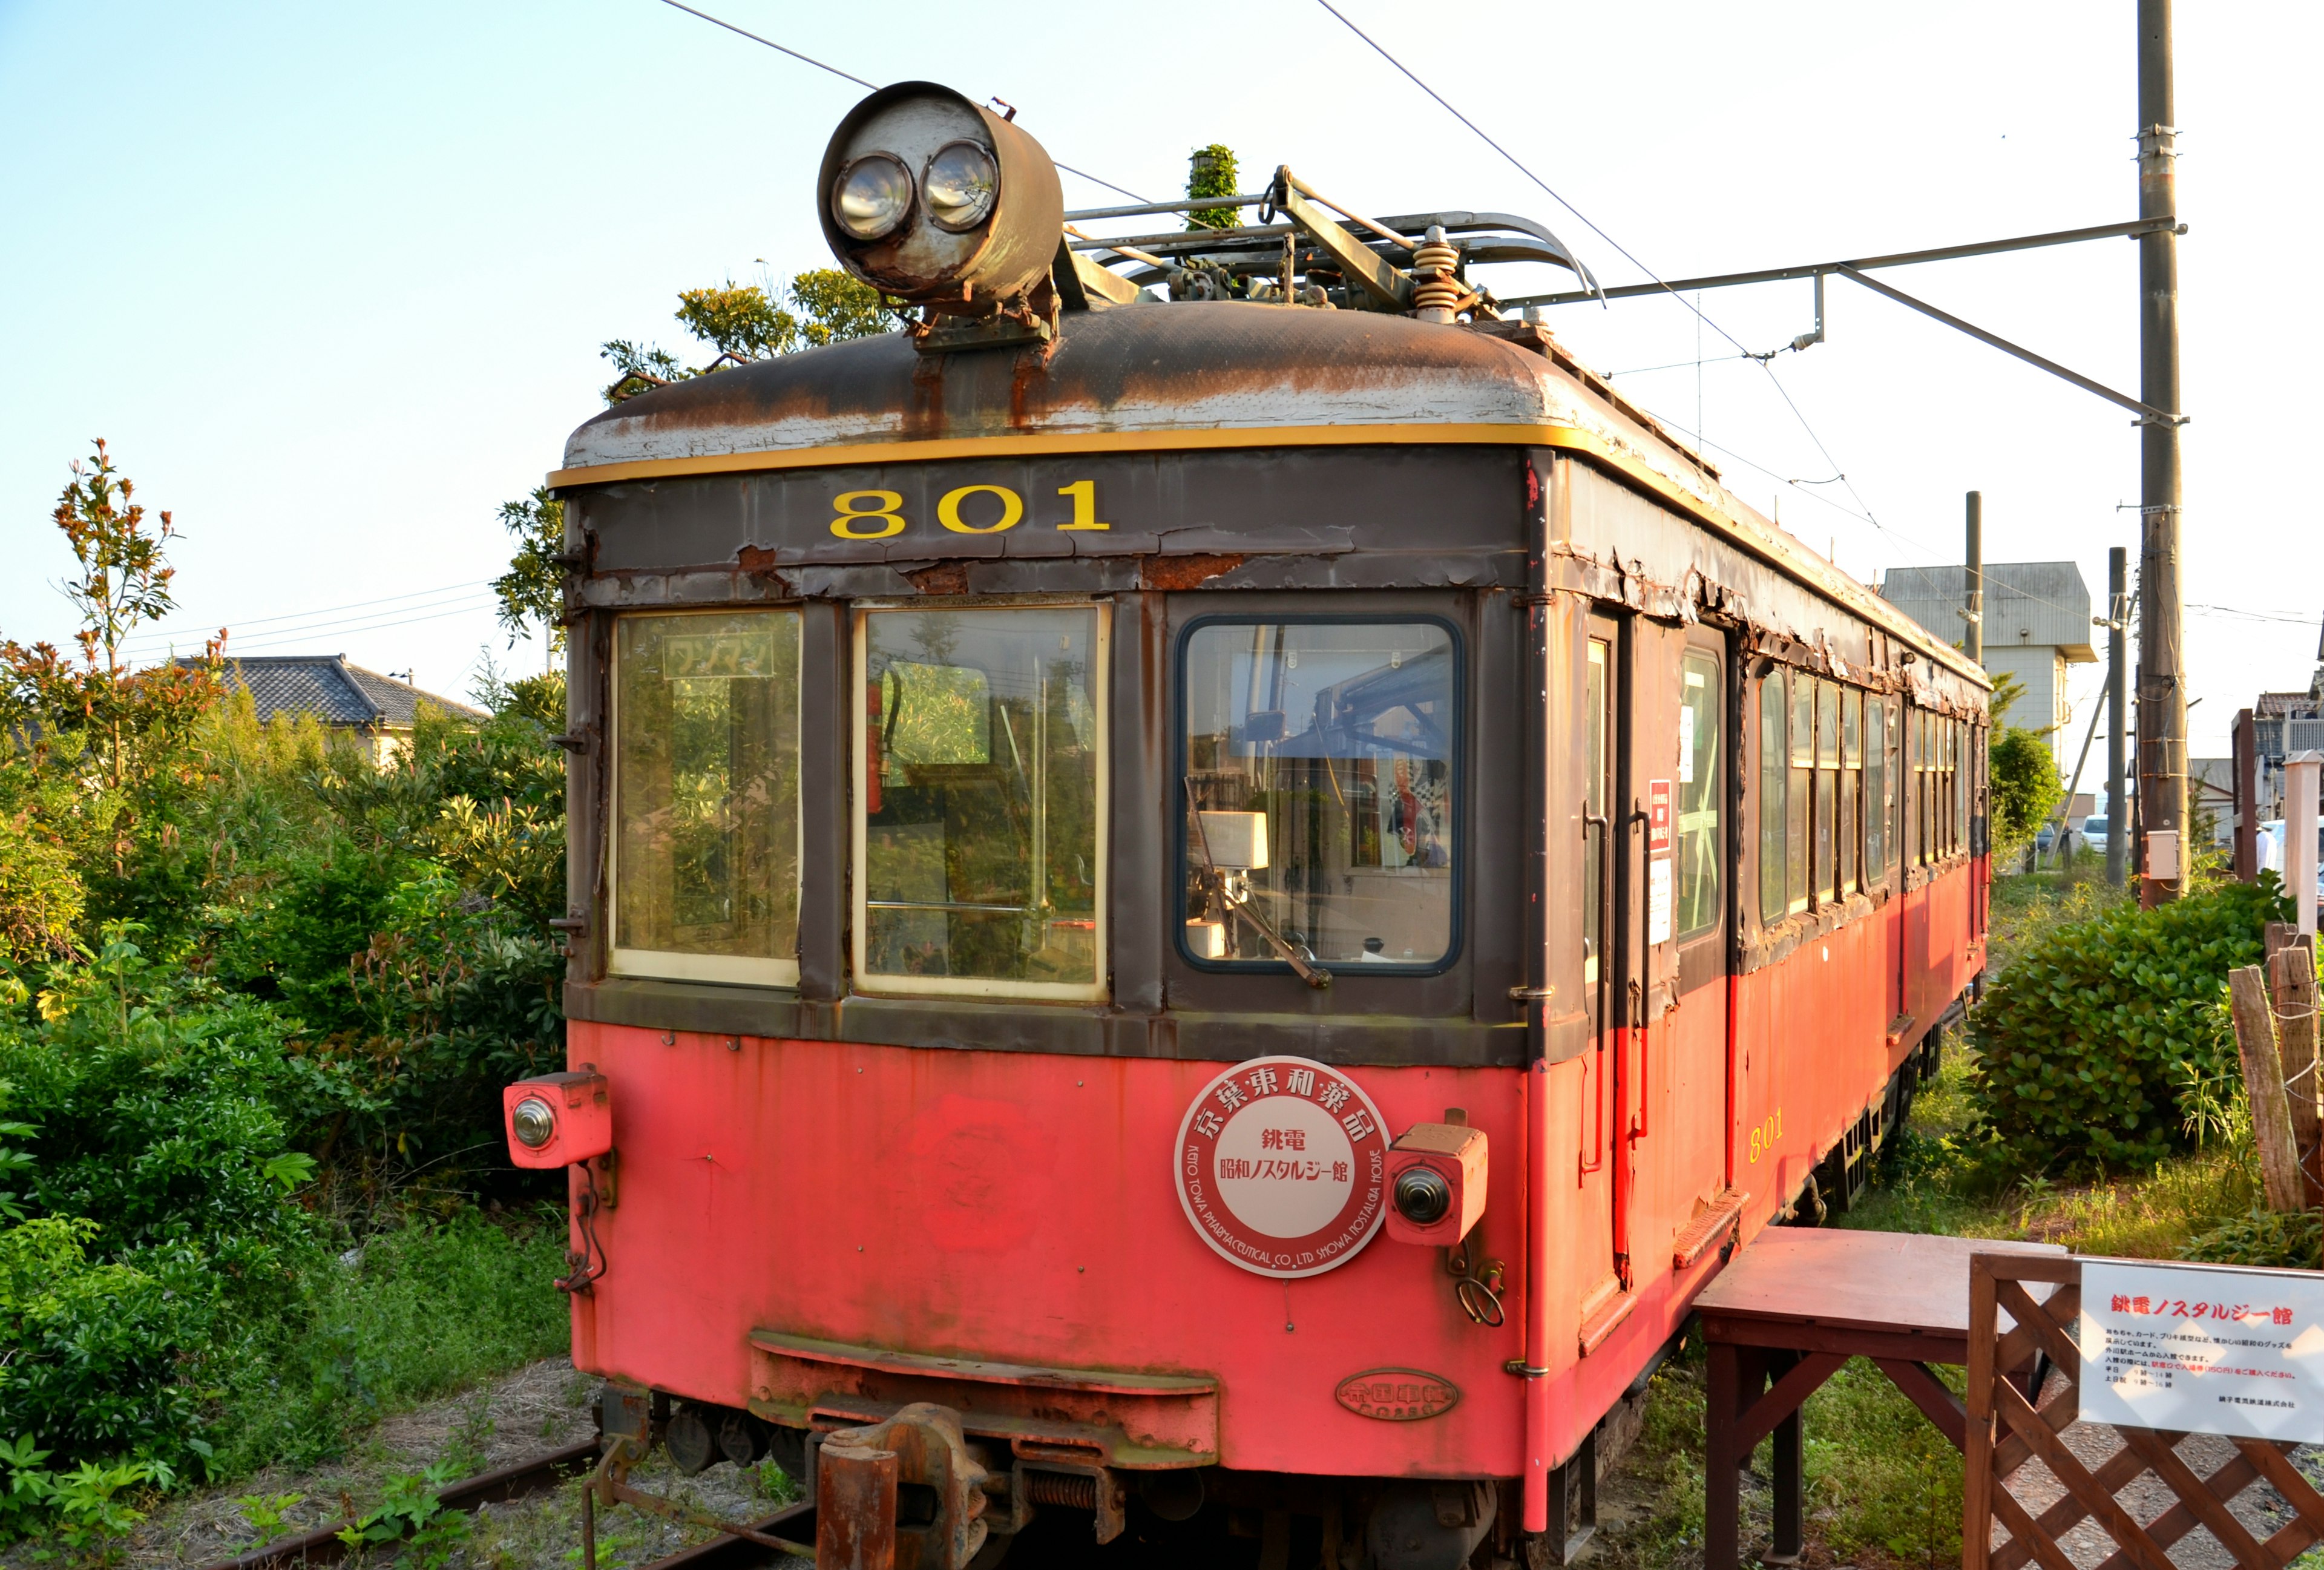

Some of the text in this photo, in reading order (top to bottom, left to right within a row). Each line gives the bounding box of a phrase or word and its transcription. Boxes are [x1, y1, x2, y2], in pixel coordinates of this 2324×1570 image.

[830, 480, 1110, 539] 801
[1193, 1068, 1375, 1142] 京葉東和薬品
[1261, 1128, 1305, 1151] 銚電
[1750, 1106, 1782, 1164] 801
[1220, 1158, 1348, 1182] 昭和ノスタルジー館
[1189, 1178, 1207, 1212] TOWA
[1203, 1211, 1270, 1264] PHARMACEUTICAL
[1316, 1233, 1353, 1260] SHOWA
[1349, 1187, 1380, 1236] NOSTALGIA
[1370, 1149, 1382, 1183] HOUSE
[2111, 1293, 2293, 1325] 銚電ノスタルジー館
